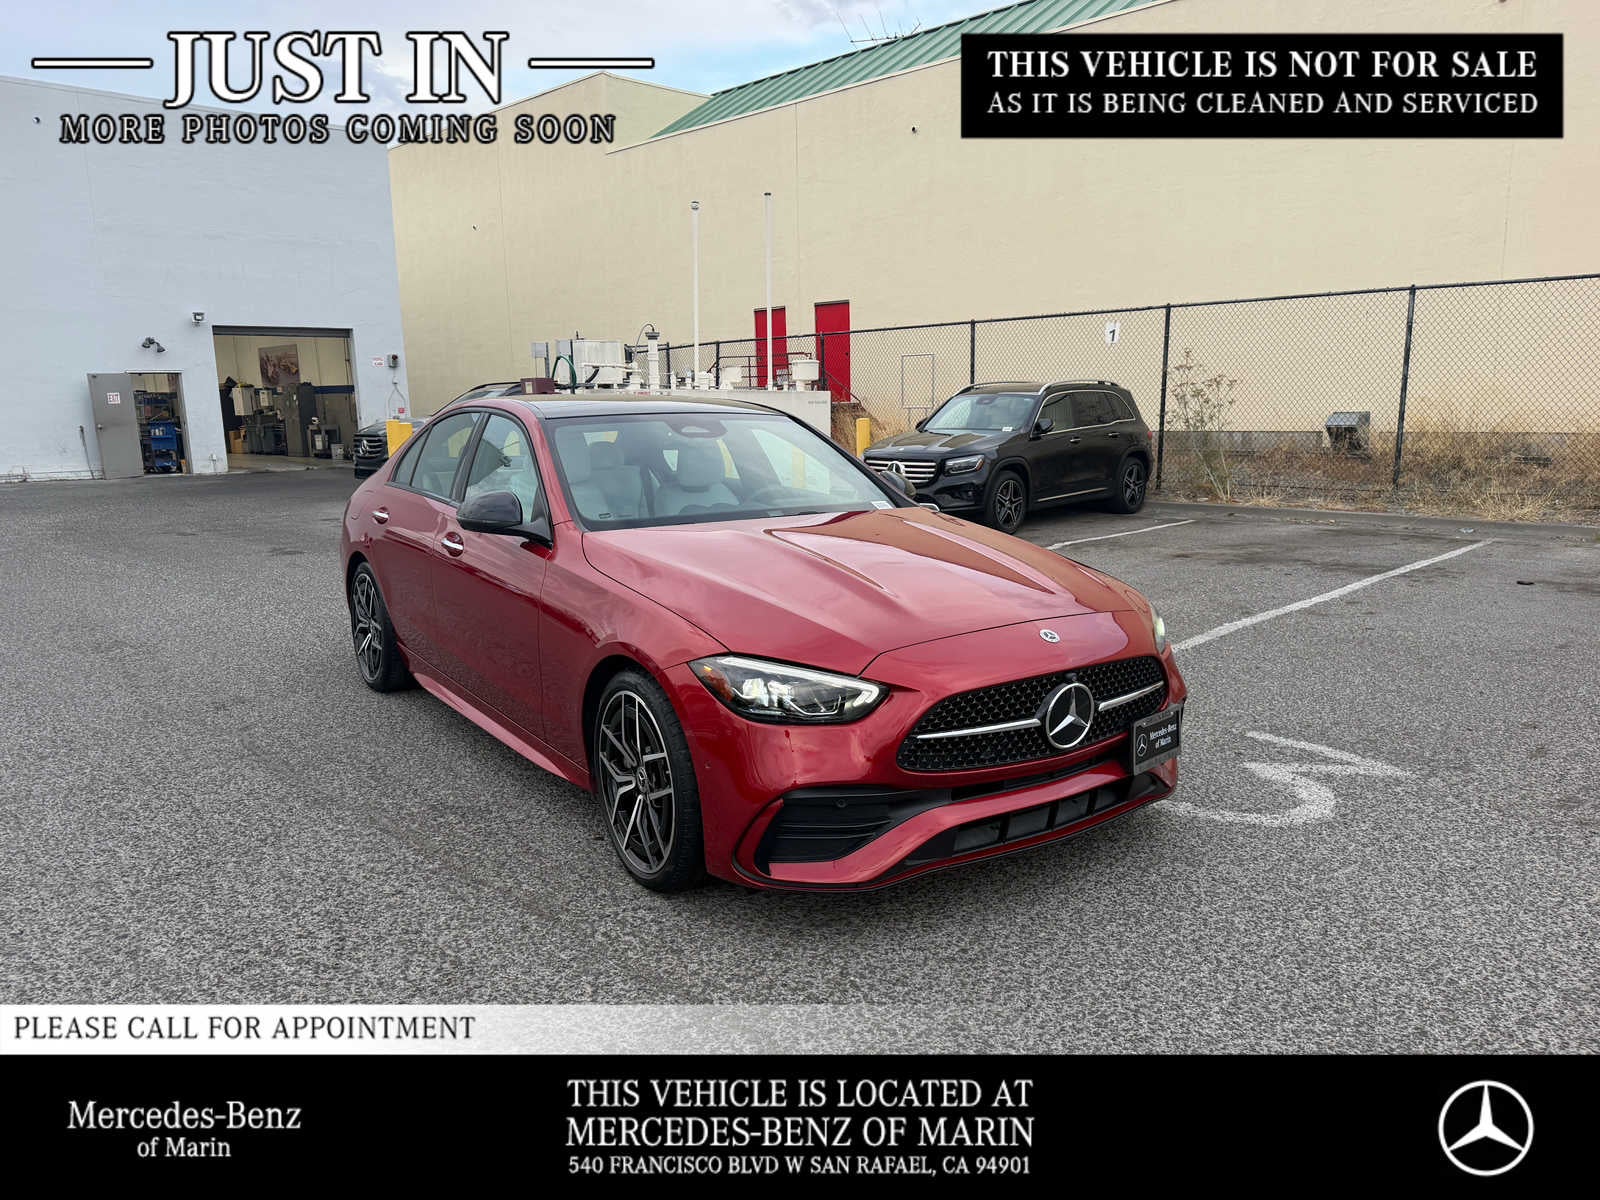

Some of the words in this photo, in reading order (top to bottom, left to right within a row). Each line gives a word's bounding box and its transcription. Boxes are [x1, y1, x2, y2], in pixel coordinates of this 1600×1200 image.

[1109, 328, 1116, 341] 1
[1150, 723, 1177, 740] Mercedes-Benz
[1155, 738, 1160, 749] of
[1160, 736, 1171, 746] Marin
